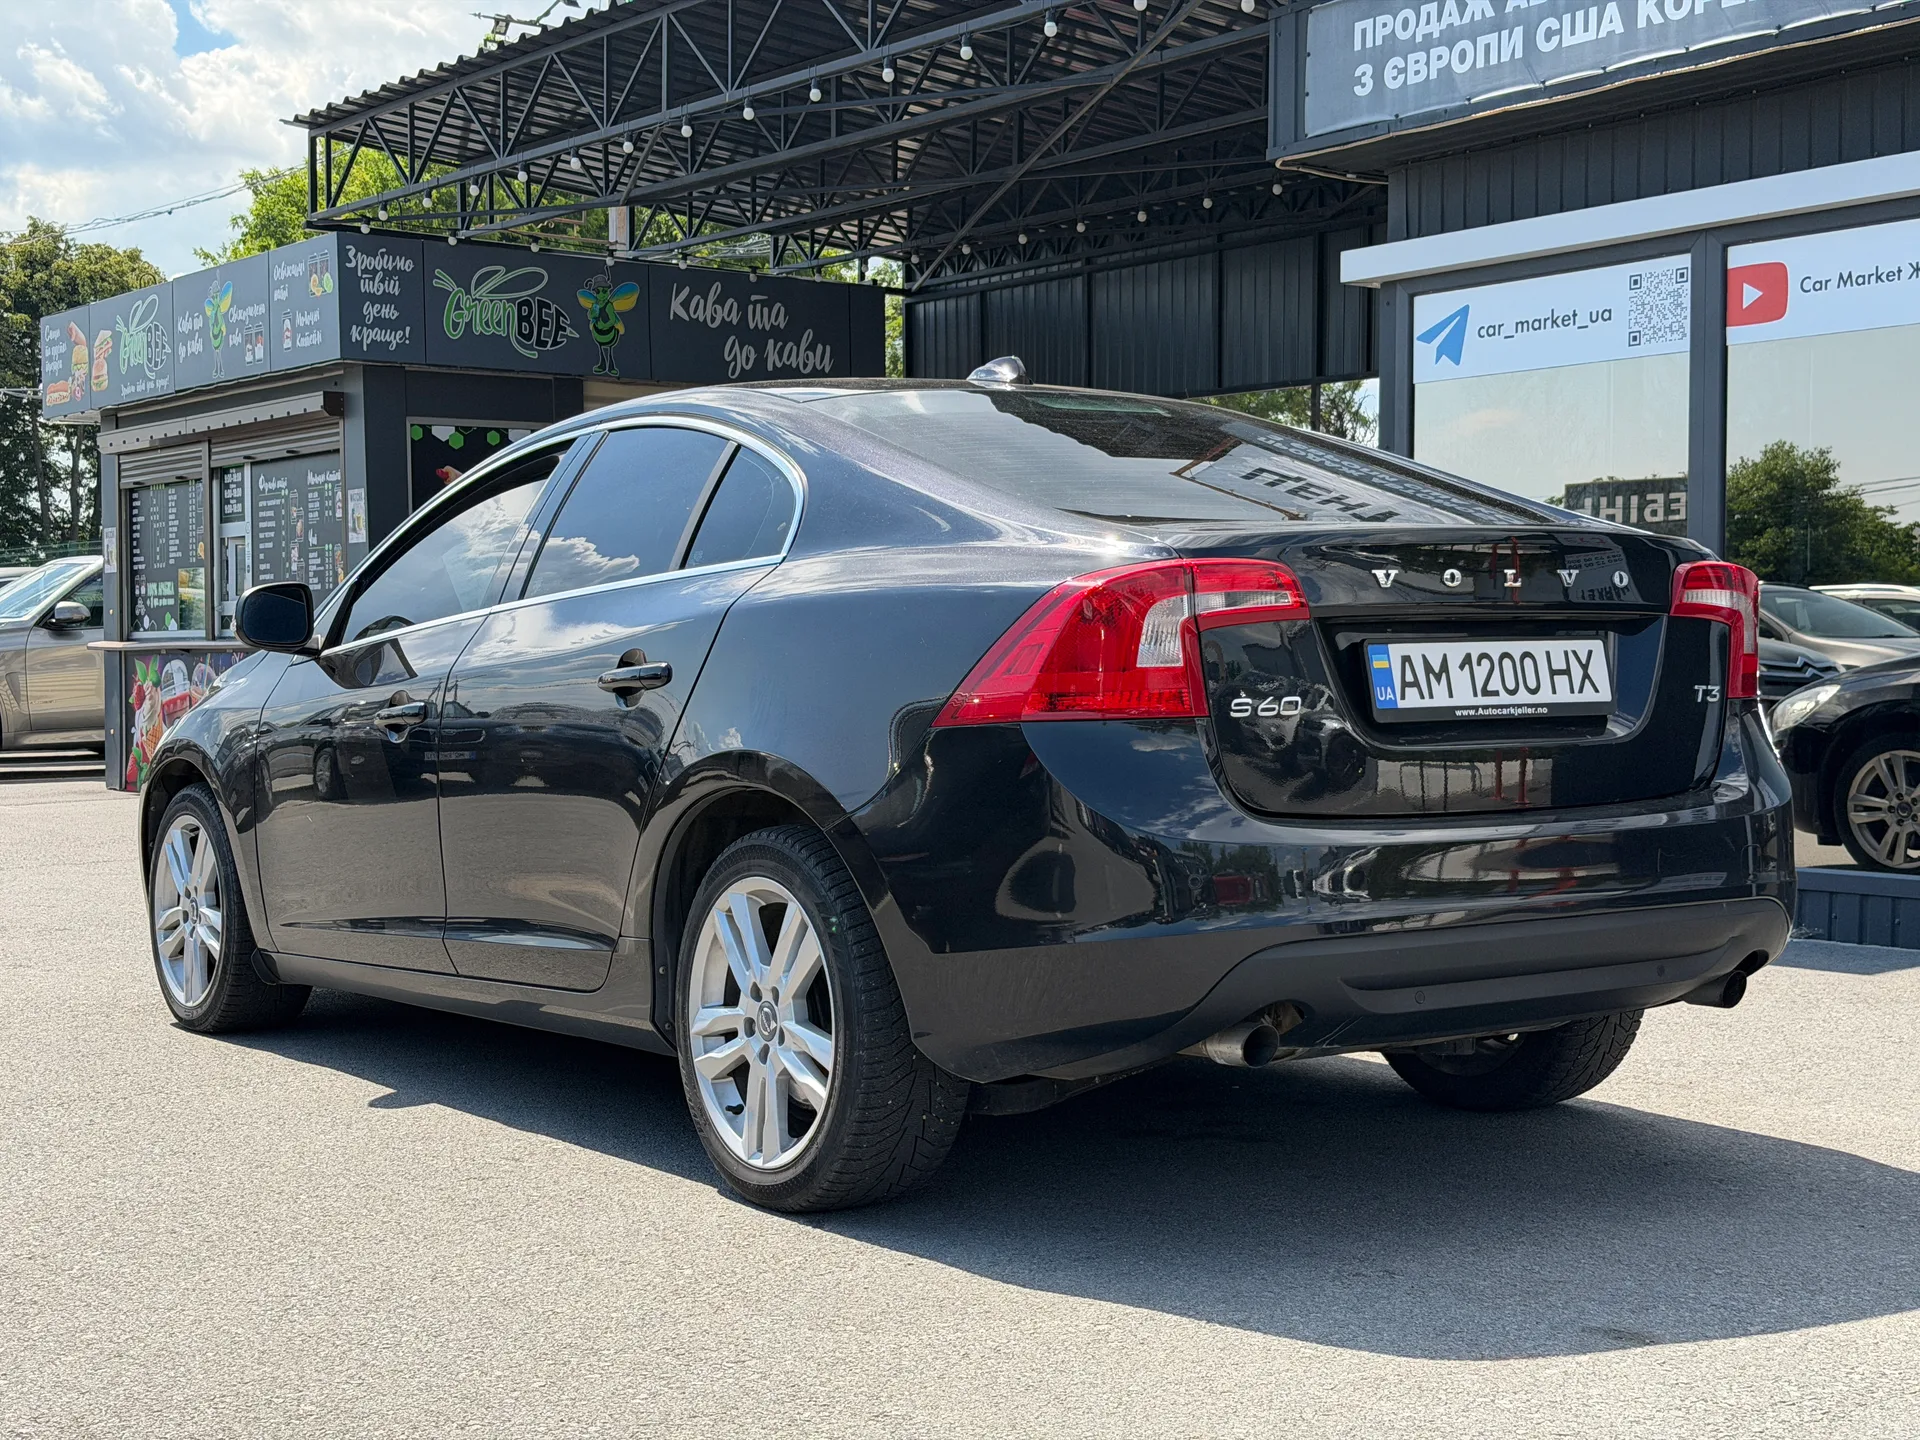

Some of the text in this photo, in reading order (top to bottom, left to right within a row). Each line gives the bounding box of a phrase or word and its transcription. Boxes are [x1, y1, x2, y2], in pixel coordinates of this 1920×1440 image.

[1354, 0, 1495, 51] ПРОДАЖ
[1353, 64, 1374, 97] З
[1384, 26, 1523, 90] ЄВРОПИ
[1536, 2, 1625, 53] США
[345, 245, 414, 277] Зробимо
[360, 271, 401, 297] твій
[1800, 276, 1832, 293] Car
[1836, 265, 1903, 289] Market
[362, 301, 400, 324] день
[670, 281, 789, 331] Кава та
[1477, 307, 1613, 340] car_market_ua
[350, 326, 411, 351] краще!
[723, 328, 835, 379] до кави
[1371, 569, 1629, 588] VOLVO
[1400, 649, 1600, 701] AM 1200 HX
[1230, 696, 1301, 718] S60
[1377, 686, 1395, 701] UA
[1694, 685, 1720, 702] T3
[1455, 705, 1548, 717] www.Autocarkjeller.no
